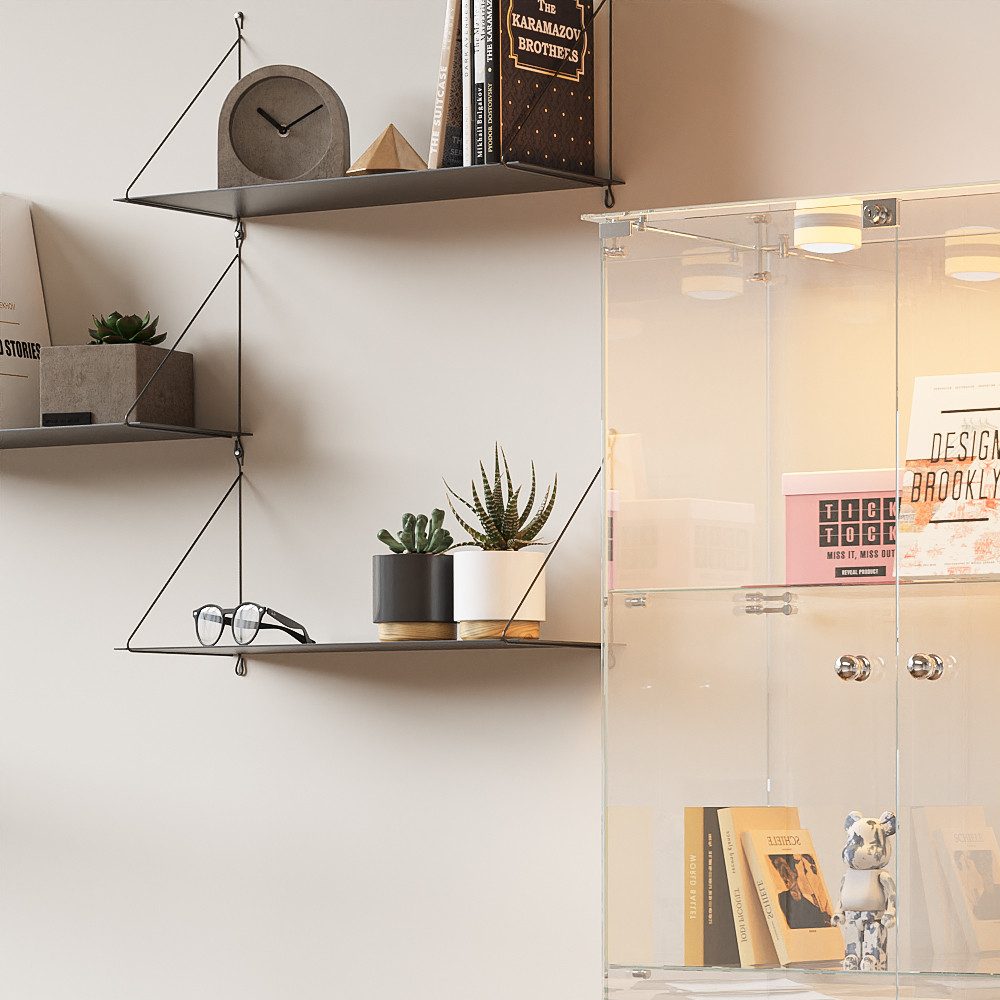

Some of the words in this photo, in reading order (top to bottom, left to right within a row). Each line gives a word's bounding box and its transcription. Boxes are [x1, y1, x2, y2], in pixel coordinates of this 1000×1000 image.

[512, 13, 582, 42] KARAMAZOV
[518, 36, 579, 63] BROTHERS
[433, 65, 448, 126] SUITCASE
[476, 87, 484, 125] Bulgakov
[430, 131, 440, 154] THE
[5, 339, 41, 360] STORIES
[825, 502, 896, 519] TICK
[825, 526, 896, 543] TOCK
[827, 551, 846, 560] MISS
[848, 550, 857, 560] IT,
[860, 549, 879, 559] MISS
[881, 549, 896, 558] OUT
